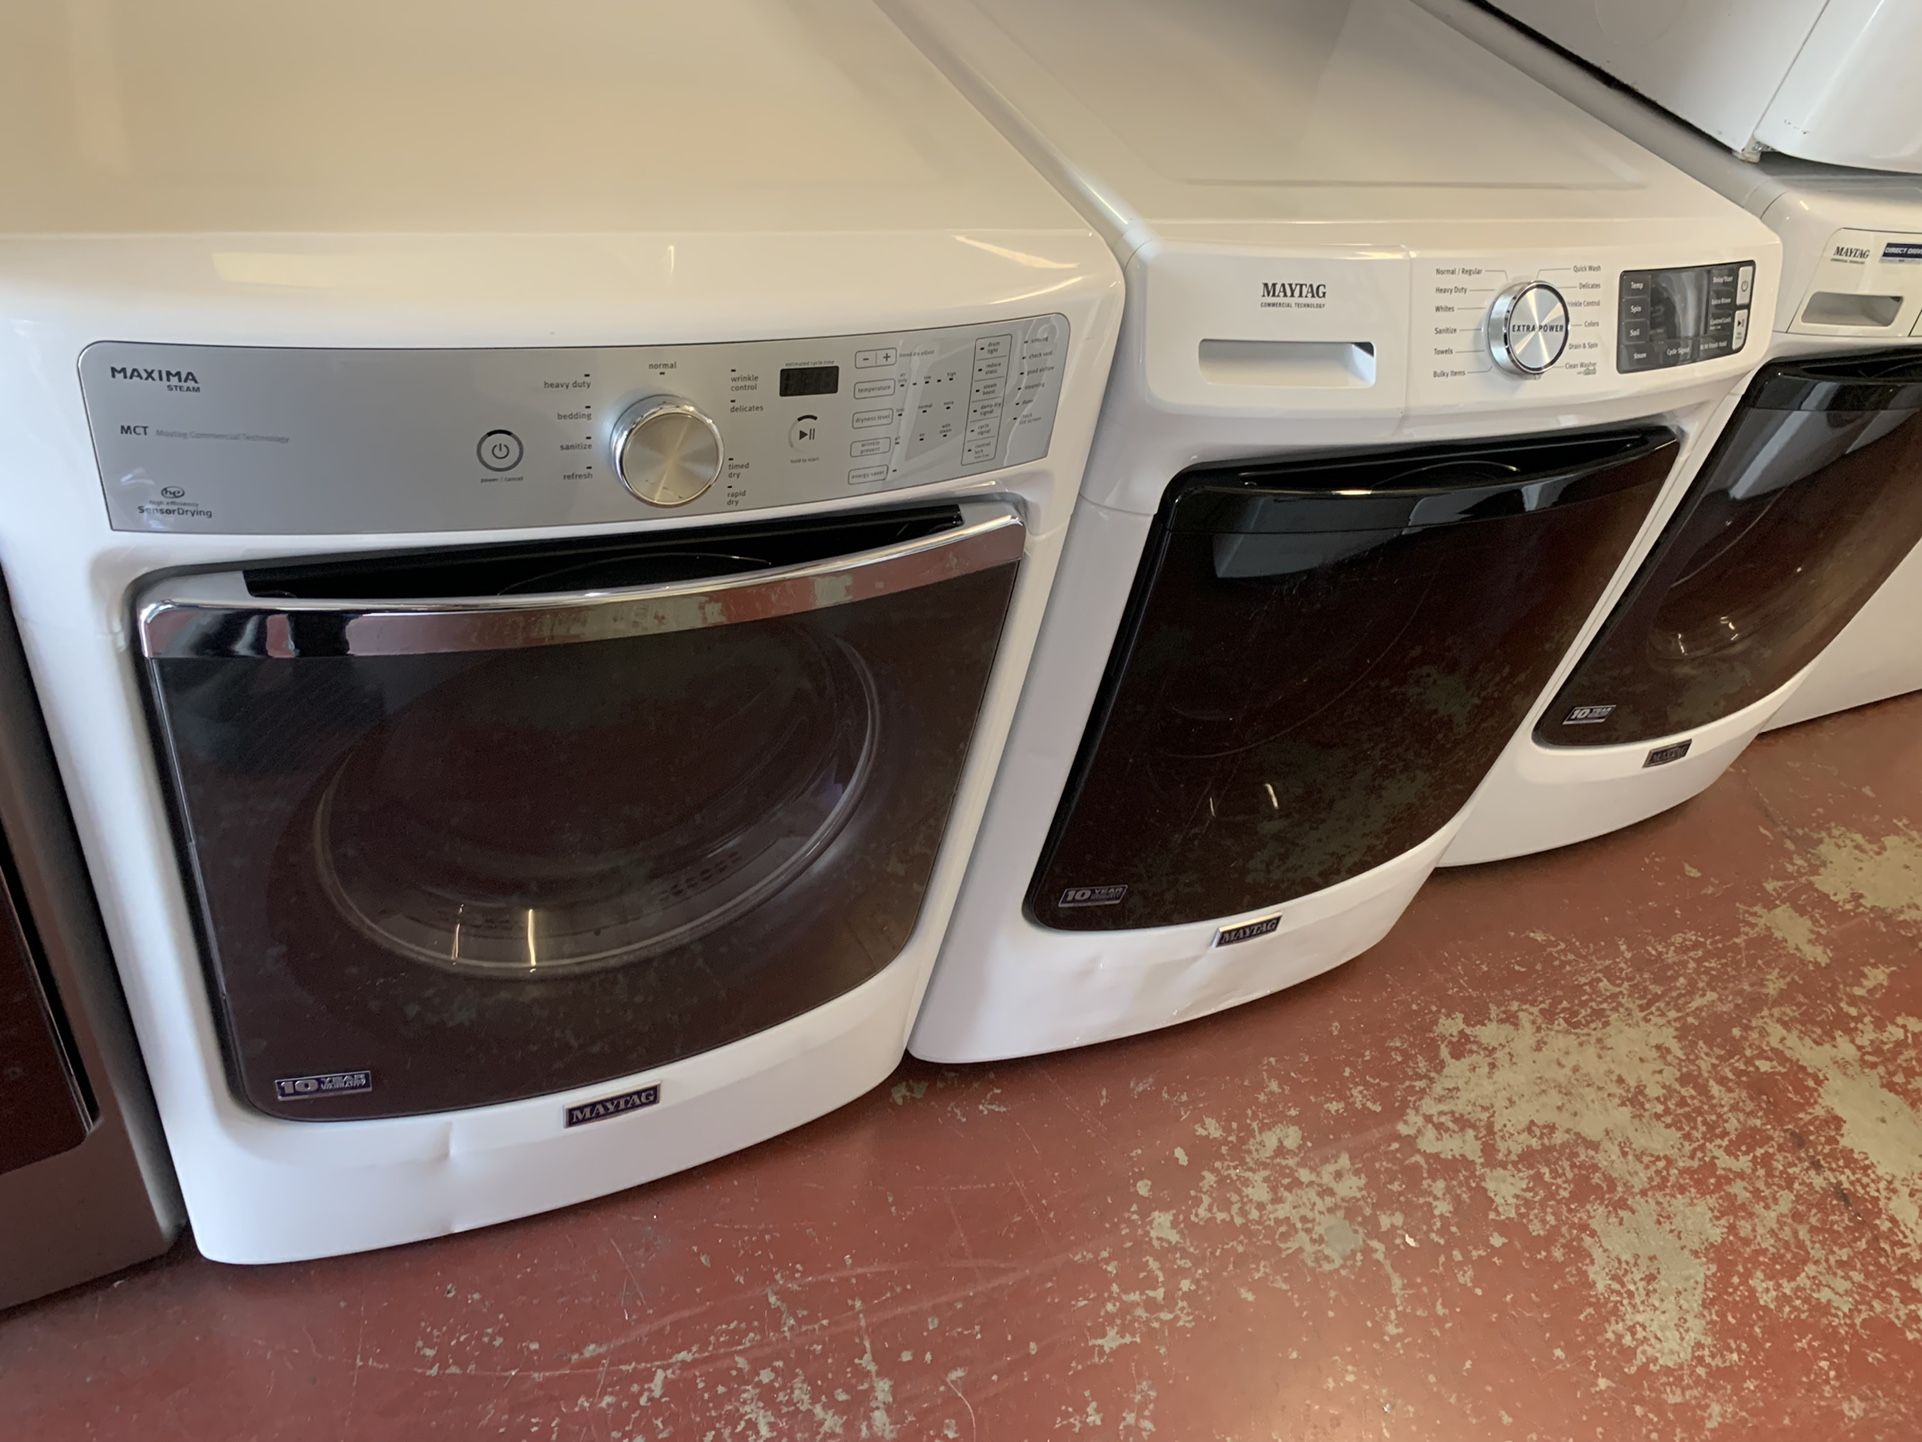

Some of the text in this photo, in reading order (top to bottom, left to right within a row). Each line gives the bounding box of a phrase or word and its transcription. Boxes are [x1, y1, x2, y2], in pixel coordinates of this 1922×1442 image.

[1833, 246, 1870, 259] MAYTAG
[1435, 267, 1456, 275] Normal
[1461, 267, 1482, 276] Regular
[1435, 285, 1467, 295] Heavy Duty
[1631, 281, 1643, 290] Temp
[1261, 282, 1327, 299] MAYTAG
[1630, 305, 1642, 314] Spin
[1434, 327, 1457, 335] Sanitize
[1512, 324, 1564, 333] EXTRA POWER
[1630, 328, 1640, 337] Soil
[1434, 347, 1454, 355] Towels
[648, 361, 677, 370] normal
[110, 366, 199, 384] MAXIMA
[731, 374, 759, 383] wrinkle
[1433, 370, 1449, 378] Bulky
[167, 385, 201, 393] STEAM
[543, 380, 592, 390] heavy duty
[730, 383, 758, 391] control
[730, 405, 764, 413] delicates
[557, 412, 592, 421] bedding
[120, 425, 149, 436] MCT
[560, 443, 593, 451] sanitize
[728, 462, 750, 470] timed
[563, 471, 593, 480] refresh
[728, 471, 741, 479] dry
[727, 490, 747, 499] rapid
[727, 499, 740, 507] dry
[137, 505, 213, 519] SensorDrying
[1570, 709, 1590, 719] 10
[1067, 890, 1092, 901] 10
[1221, 921, 1277, 943] MAYTAG
[281, 1080, 319, 1094] 10
[571, 1090, 655, 1122] MAYTAG
